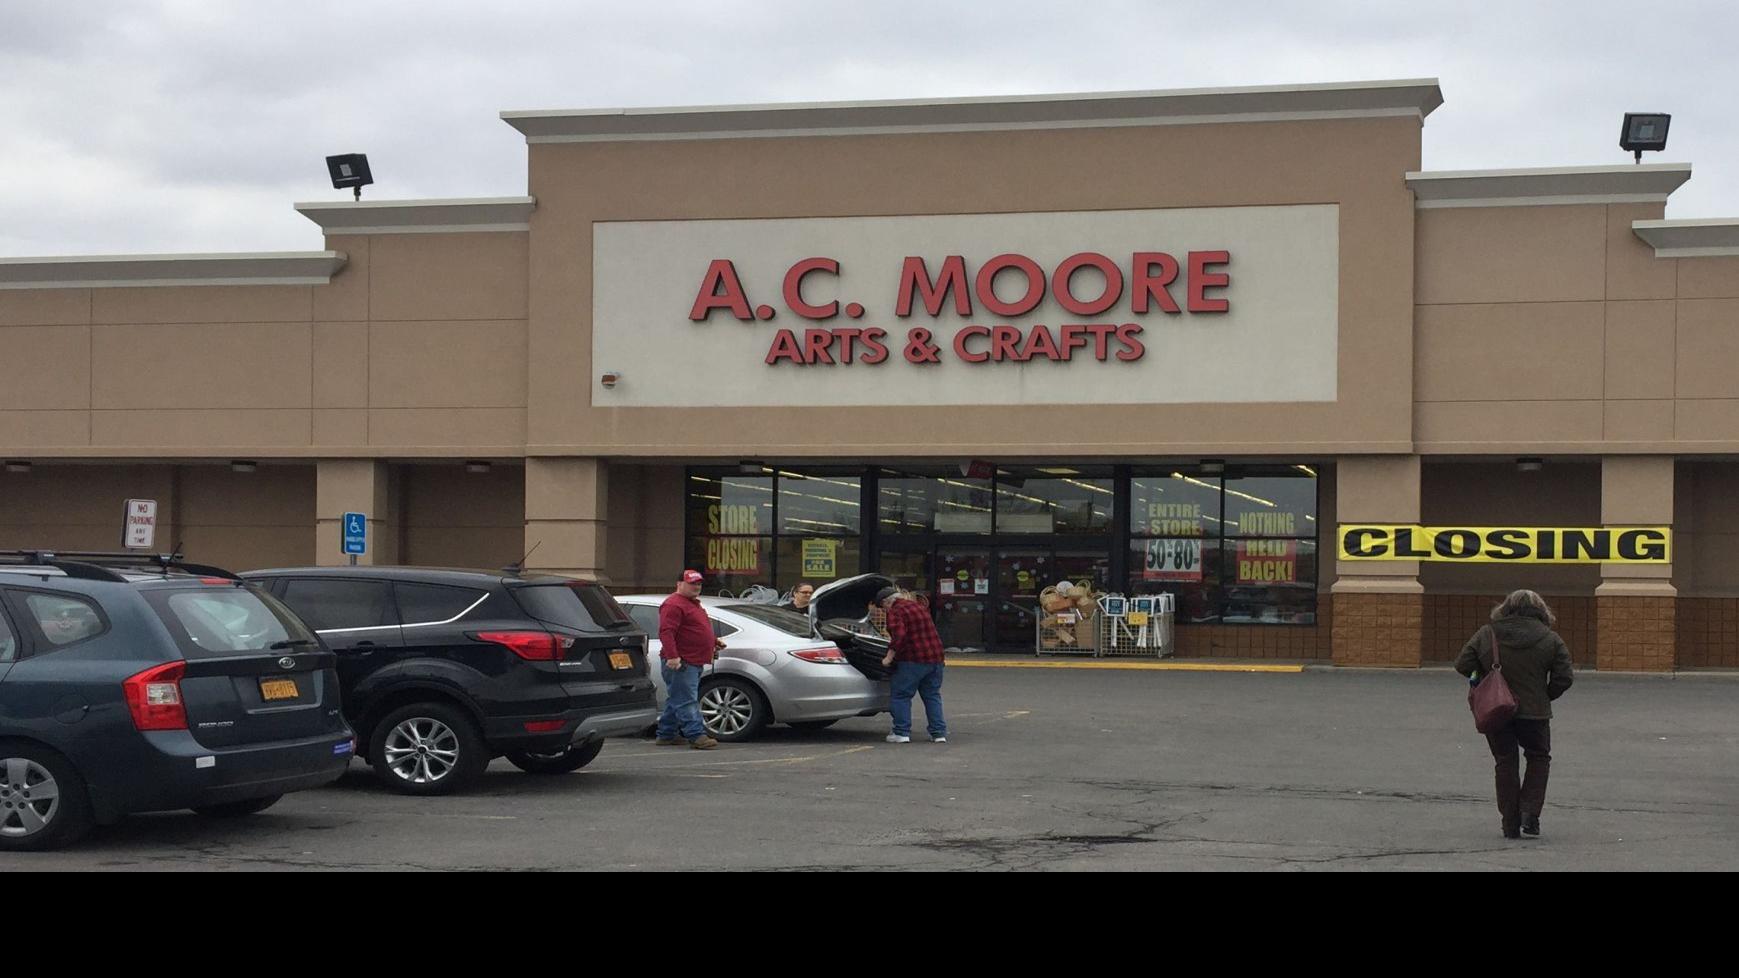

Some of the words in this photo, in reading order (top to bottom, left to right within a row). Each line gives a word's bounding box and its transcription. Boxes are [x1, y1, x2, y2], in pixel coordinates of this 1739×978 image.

[688, 256, 865, 322] A.C.
[895, 250, 1231, 318] MOORE
[765, 327, 888, 365] ARTS
[903, 327, 941, 364] &
[953, 323, 1145, 363] CRAFTS
[137, 504, 148, 513] NO
[708, 505, 757, 534] STORE
[1149, 504, 1200, 517] ENTIRE
[1151, 519, 1200, 535] STORE
[1239, 512, 1295, 534] NOTHING
[707, 539, 757, 569] CLOSING
[1246, 540, 1287, 556] HELD
[1343, 528, 1665, 560] CLOSING
[1239, 560, 1293, 581] BACK!
